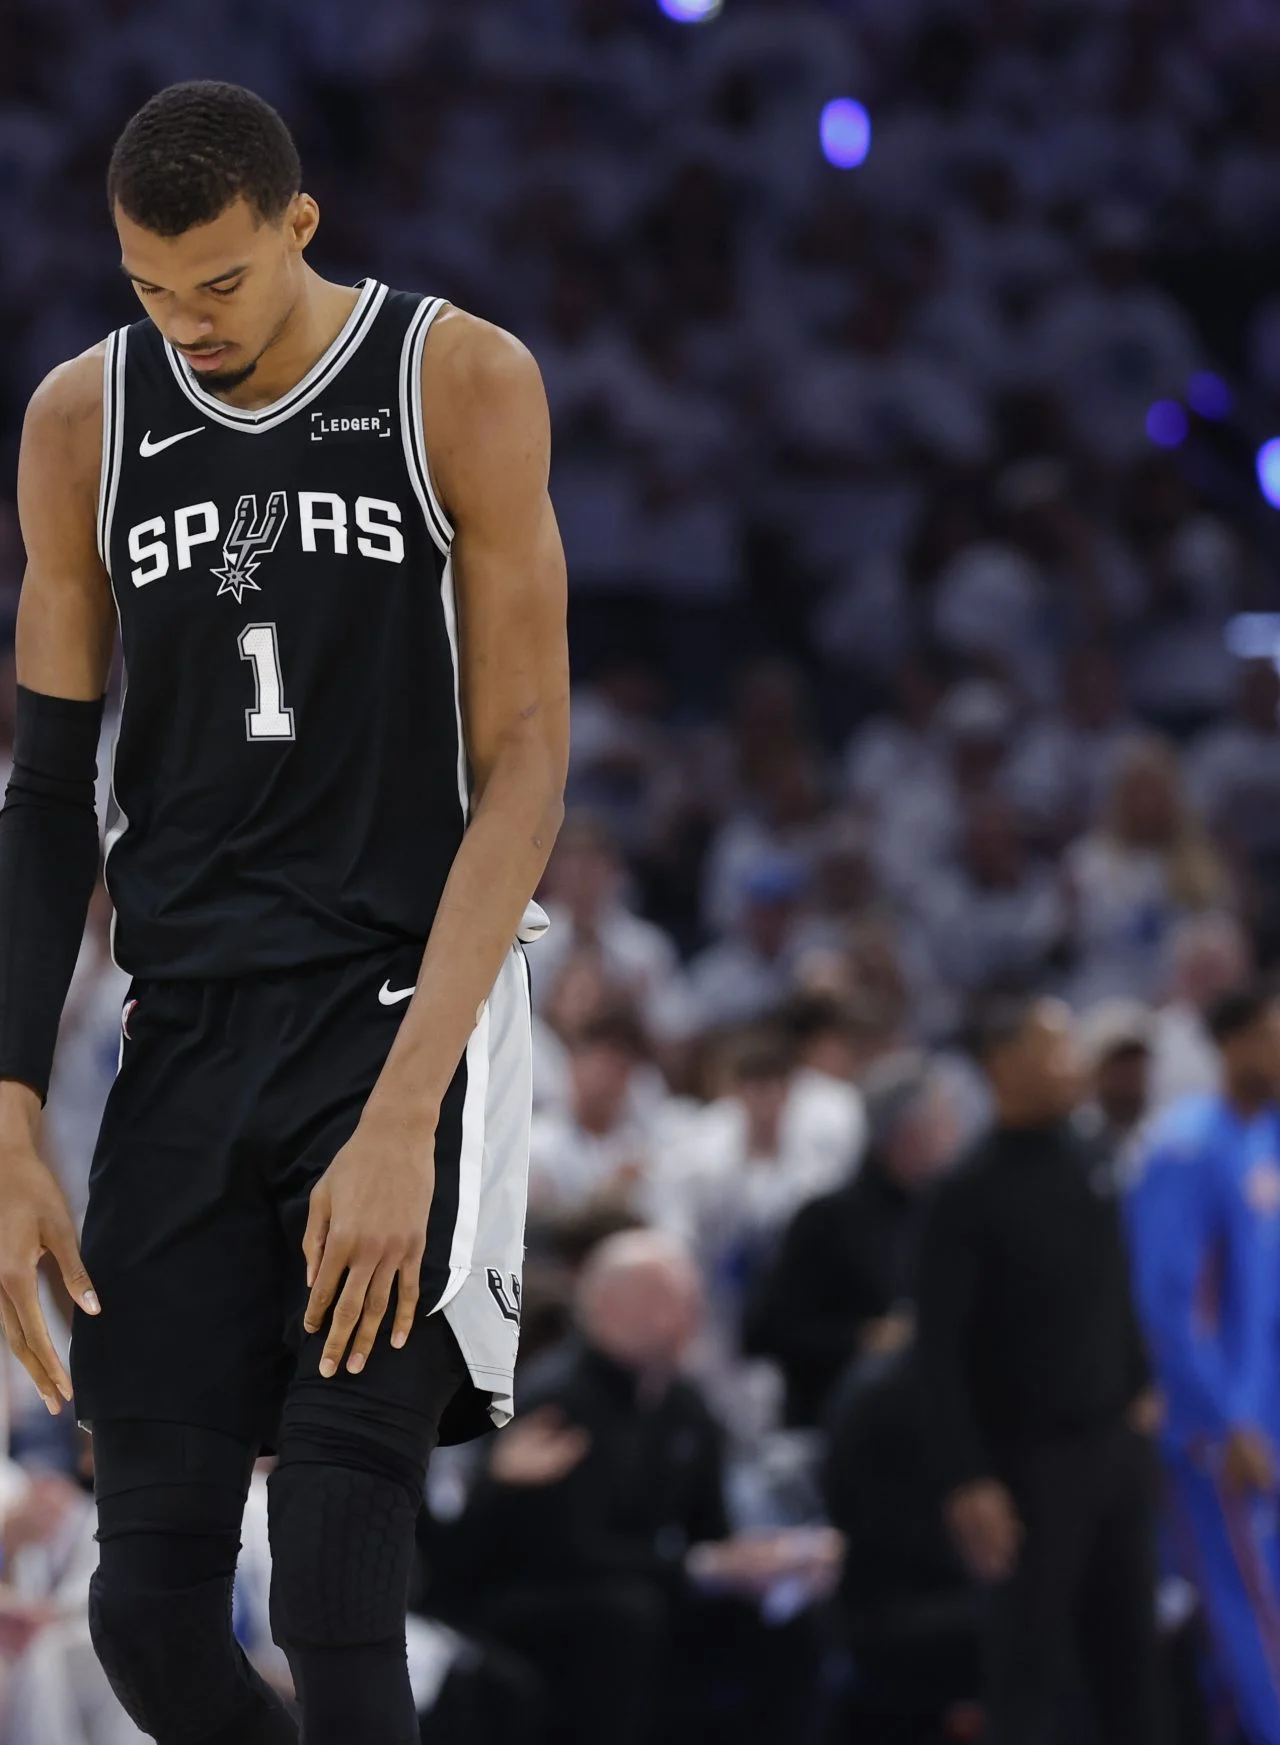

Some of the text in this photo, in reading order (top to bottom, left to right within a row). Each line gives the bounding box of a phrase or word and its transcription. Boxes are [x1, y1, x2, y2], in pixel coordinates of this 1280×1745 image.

[320, 416, 380, 432] LEDGER
[127, 490, 405, 604] SPURS
[237, 622, 295, 741] 1
